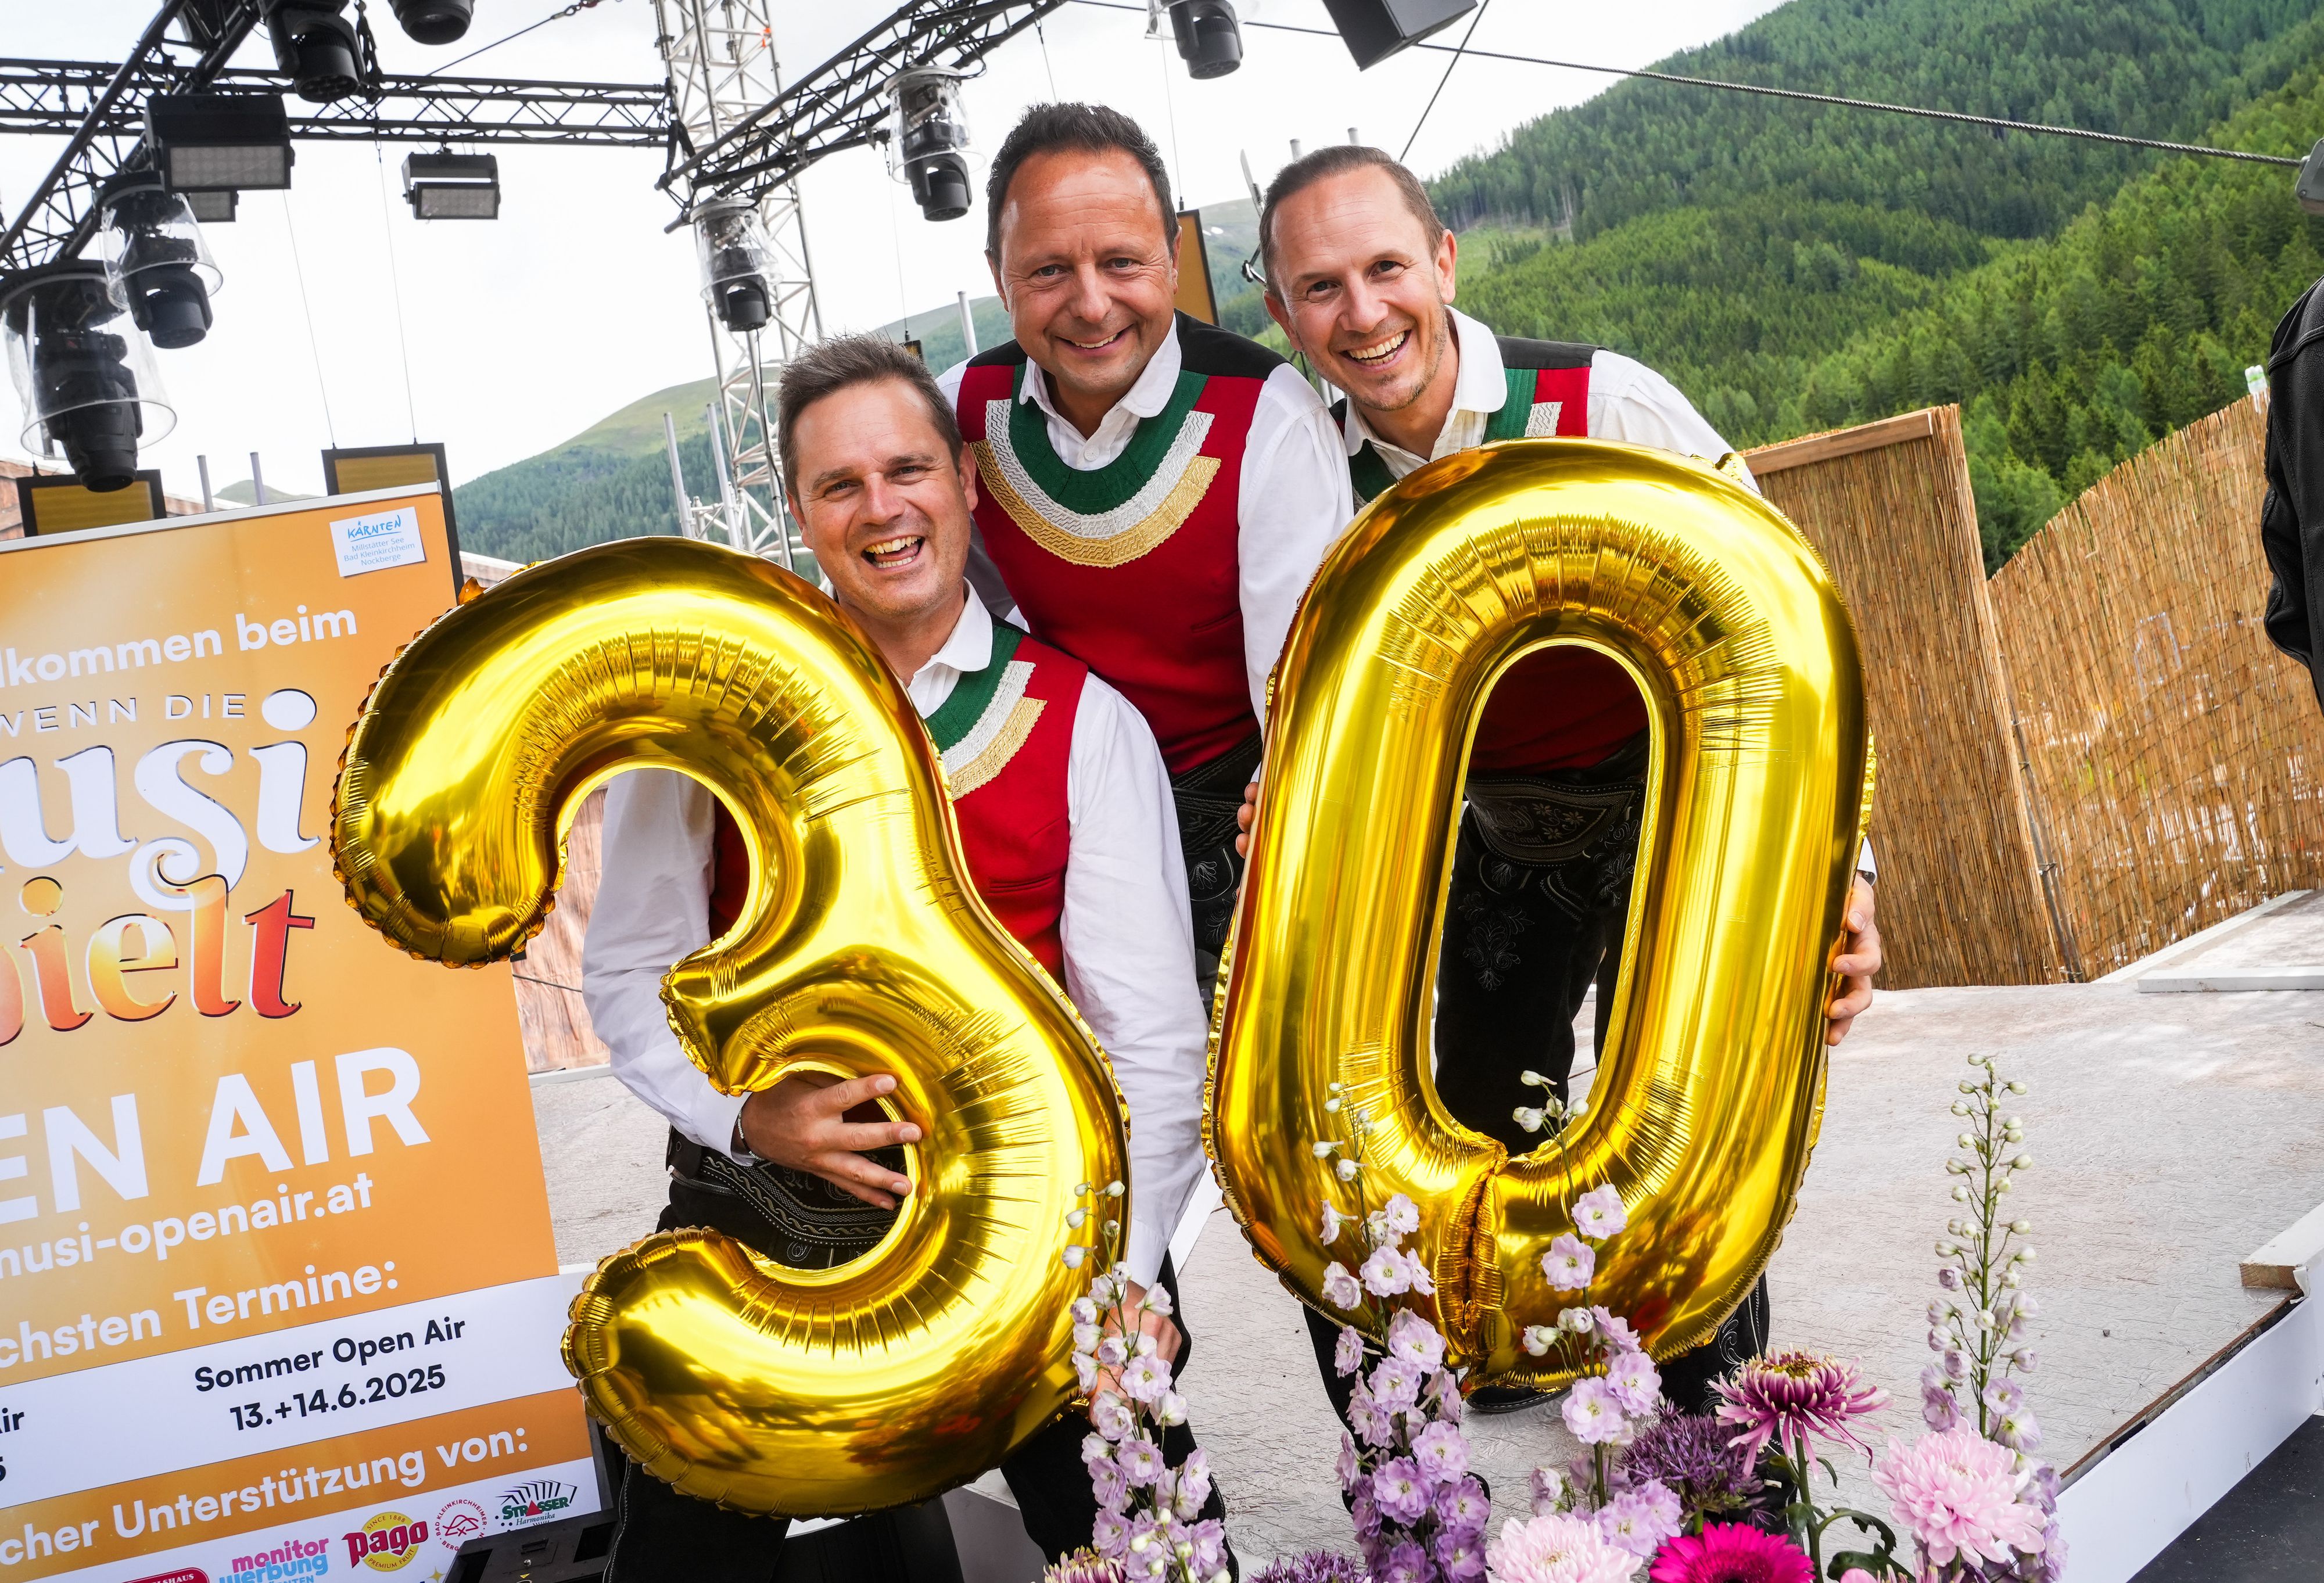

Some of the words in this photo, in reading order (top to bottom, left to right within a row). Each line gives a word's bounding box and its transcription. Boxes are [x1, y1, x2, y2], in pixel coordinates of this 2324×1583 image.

[347, 515, 401, 539] KÄRNTEN
[343, 553, 358, 562] Bad
[360, 543, 415, 558] Kleinkirchheim
[361, 554, 401, 566] Nockberge
[235, 605, 357, 651] beim
[165, 693, 247, 720] DIE
[196, 1047, 432, 1187] AIR
[0, 1306, 162, 1369] chsten
[173, 1261, 399, 1330] Termine:
[195, 1349, 324, 1392] Sommer
[332, 1331, 415, 1366] Open
[424, 1316, 465, 1345] Air
[0, 1408, 24, 1434] ir
[0, 1519, 101, 1566] cher
[113, 1450, 426, 1539] Unterstützung
[435, 1427, 529, 1469] von:
[367, 1515, 386, 1530] SINCE
[389, 1514, 406, 1523] 1888
[437, 1499, 487, 1525] KLEINKIRCHHEIMER
[516, 1512, 555, 1525] Harmonika
[232, 1538, 329, 1573] monitor
[341, 1521, 429, 1568] pago
[218, 1554, 329, 1583] werbung
[368, 1557, 397, 1569] PREMIUM
[399, 1548, 414, 1564] FRUIT
